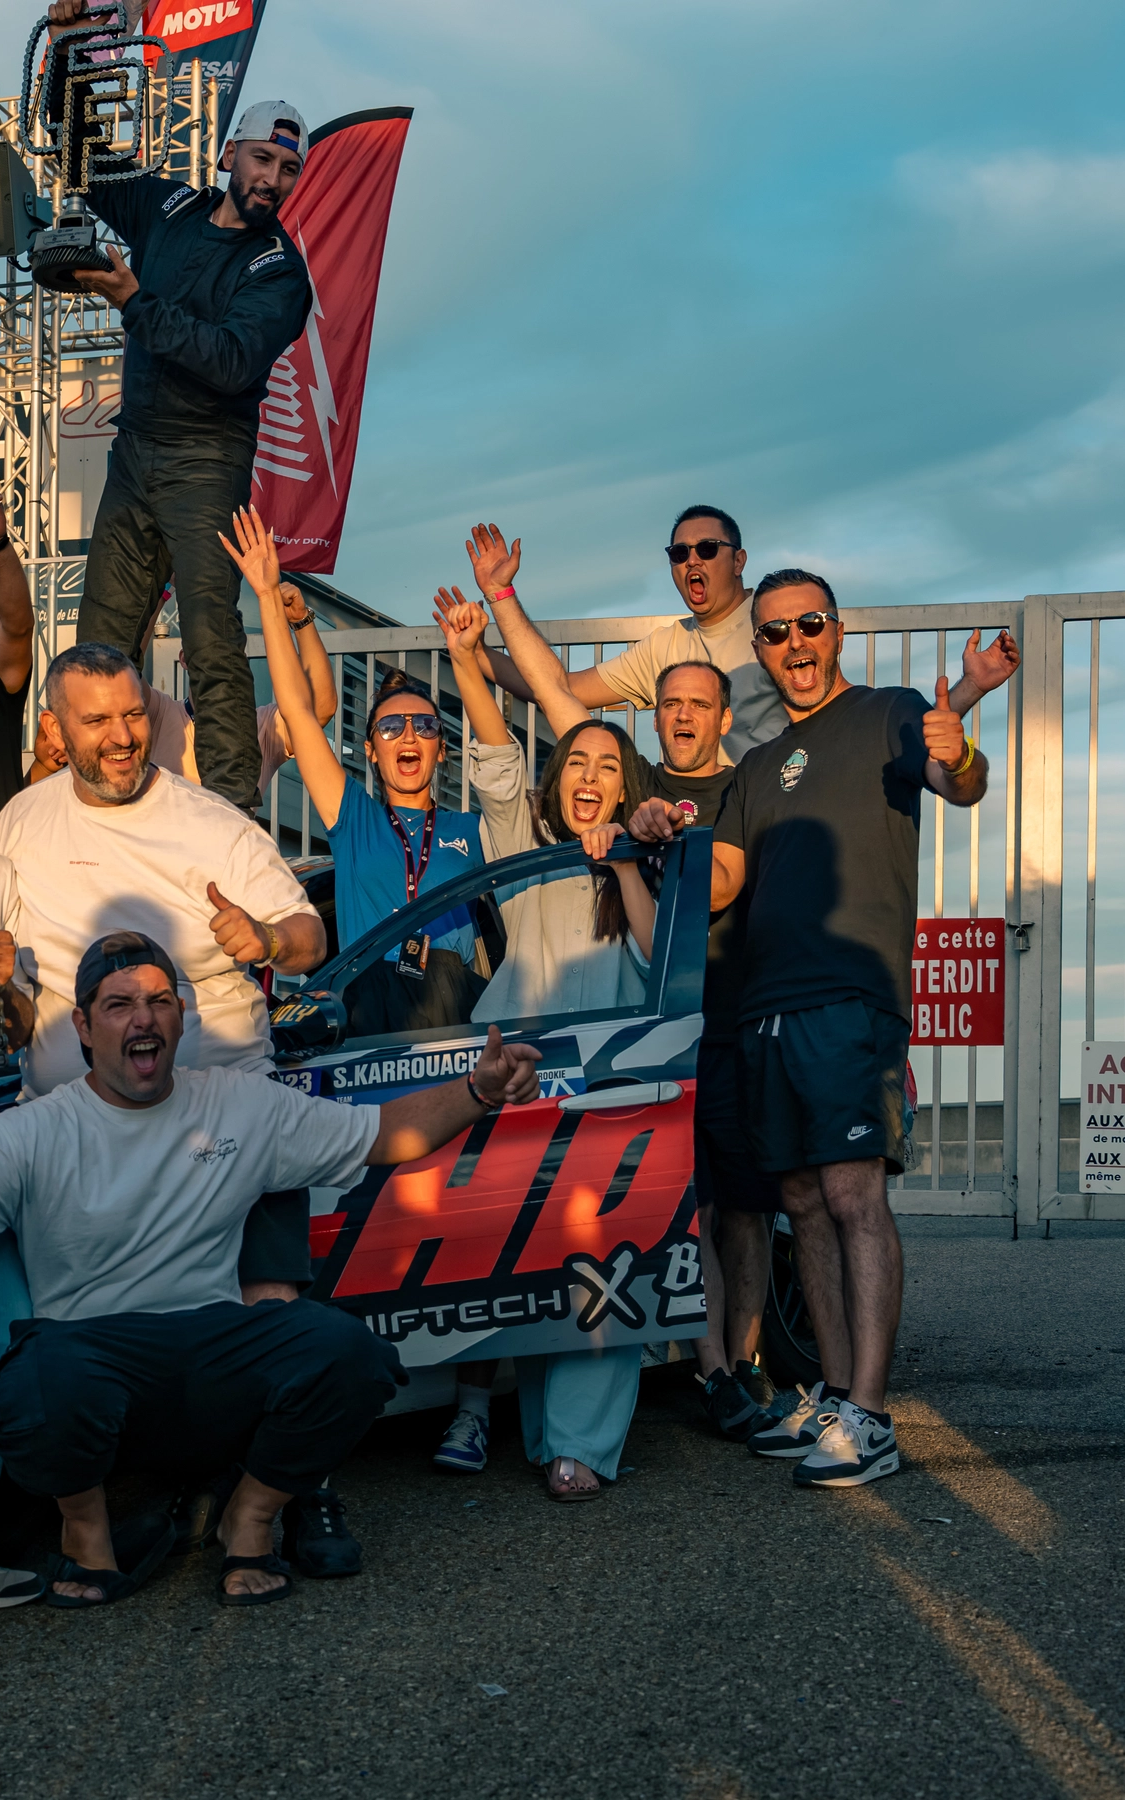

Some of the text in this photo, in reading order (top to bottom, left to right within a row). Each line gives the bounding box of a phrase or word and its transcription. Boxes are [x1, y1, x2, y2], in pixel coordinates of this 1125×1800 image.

[161, 1, 241, 37] MOTUL
[161, 185, 192, 212] sparco
[248, 253, 285, 273] sparco
[938, 927, 996, 949] cette
[911, 958, 1000, 994] TERDIT
[910, 1003, 973, 1038] BLIC
[280, 1072, 312, 1094] 23
[336, 1096, 353, 1104] TEAM
[851, 1125, 867, 1135] NIKE
[1086, 1115, 1124, 1127] AUX
[1093, 1134, 1108, 1143] de
[1086, 1153, 1121, 1165] AUX
[1085, 1171, 1121, 1182] même
[661, 1241, 704, 1292] B
